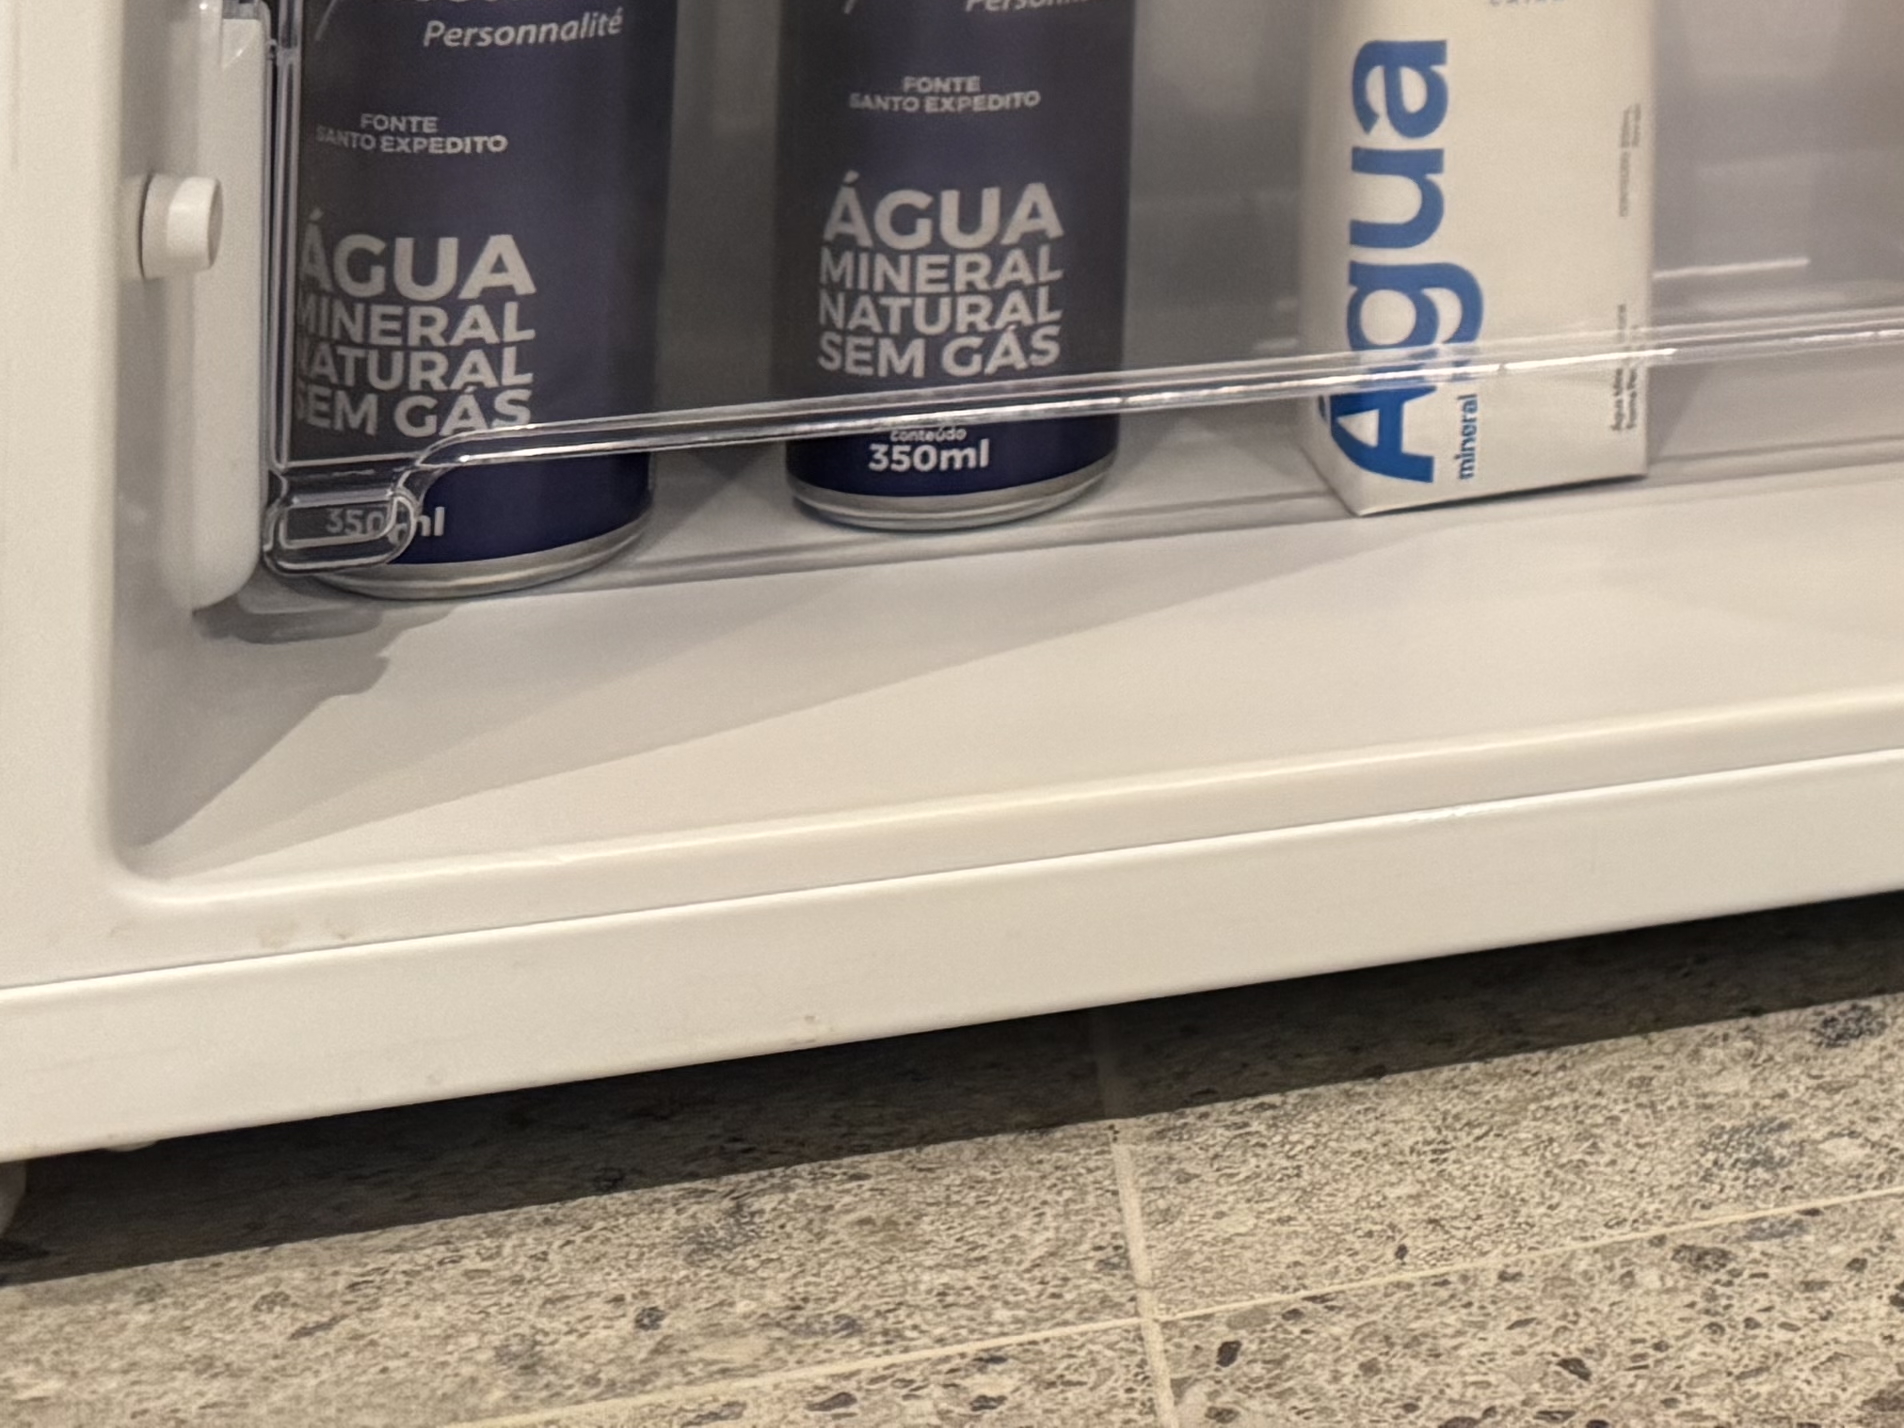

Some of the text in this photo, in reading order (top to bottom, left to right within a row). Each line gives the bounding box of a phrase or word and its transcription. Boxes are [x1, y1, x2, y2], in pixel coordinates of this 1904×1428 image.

[423, 7, 624, 48] Personnalité
[849, 90, 1042, 114] SANTO EXPEDITO
[902, 76, 981, 94] FONTE
[316, 125, 509, 154] SANTO EXPEDITO
[360, 113, 438, 134] FONTE
[822, 169, 1065, 250] ÁGUA
[301, 207, 537, 302] ÁGUA
[819, 244, 1064, 294] MINERAL
[818, 285, 1064, 336] NATURAL
[817, 322, 1062, 379] SEM GÁS
[392, 388, 532, 439] GÁS
[1454, 392, 1479, 482] mineral
[868, 439, 990, 473] 350ml
